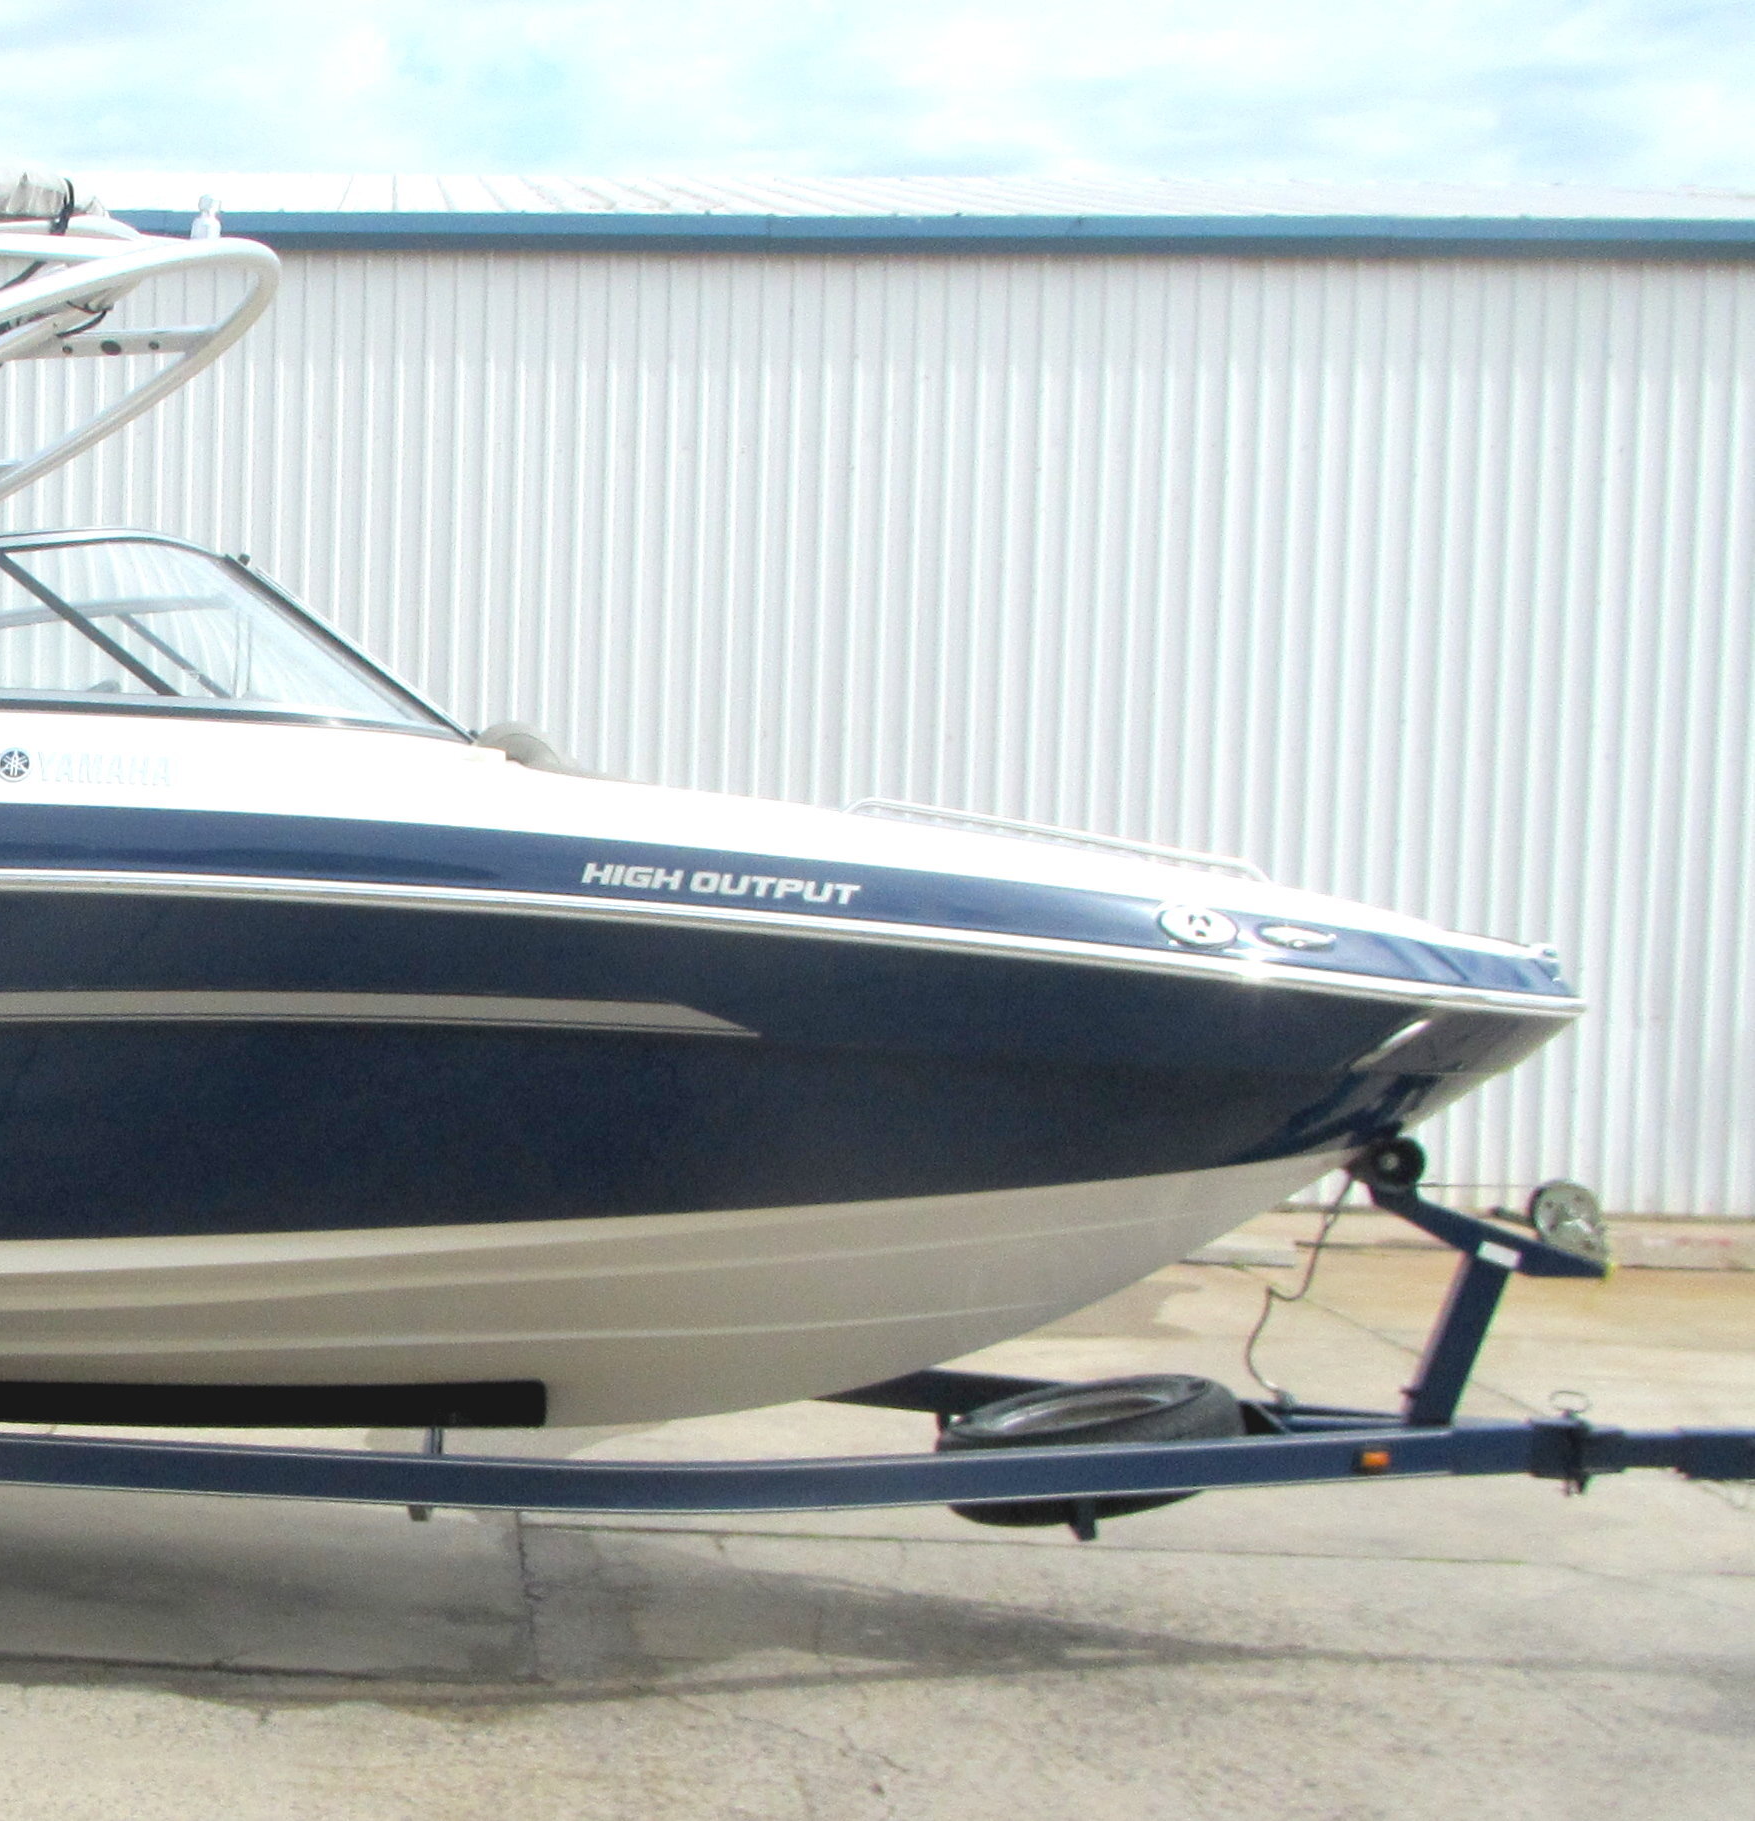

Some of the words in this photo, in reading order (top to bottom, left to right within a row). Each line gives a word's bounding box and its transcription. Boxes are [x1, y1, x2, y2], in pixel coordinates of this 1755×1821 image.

[37, 751, 173, 787] YAMAHA
[581, 862, 684, 891] HIGH
[689, 870, 861, 905] OUTPUT
